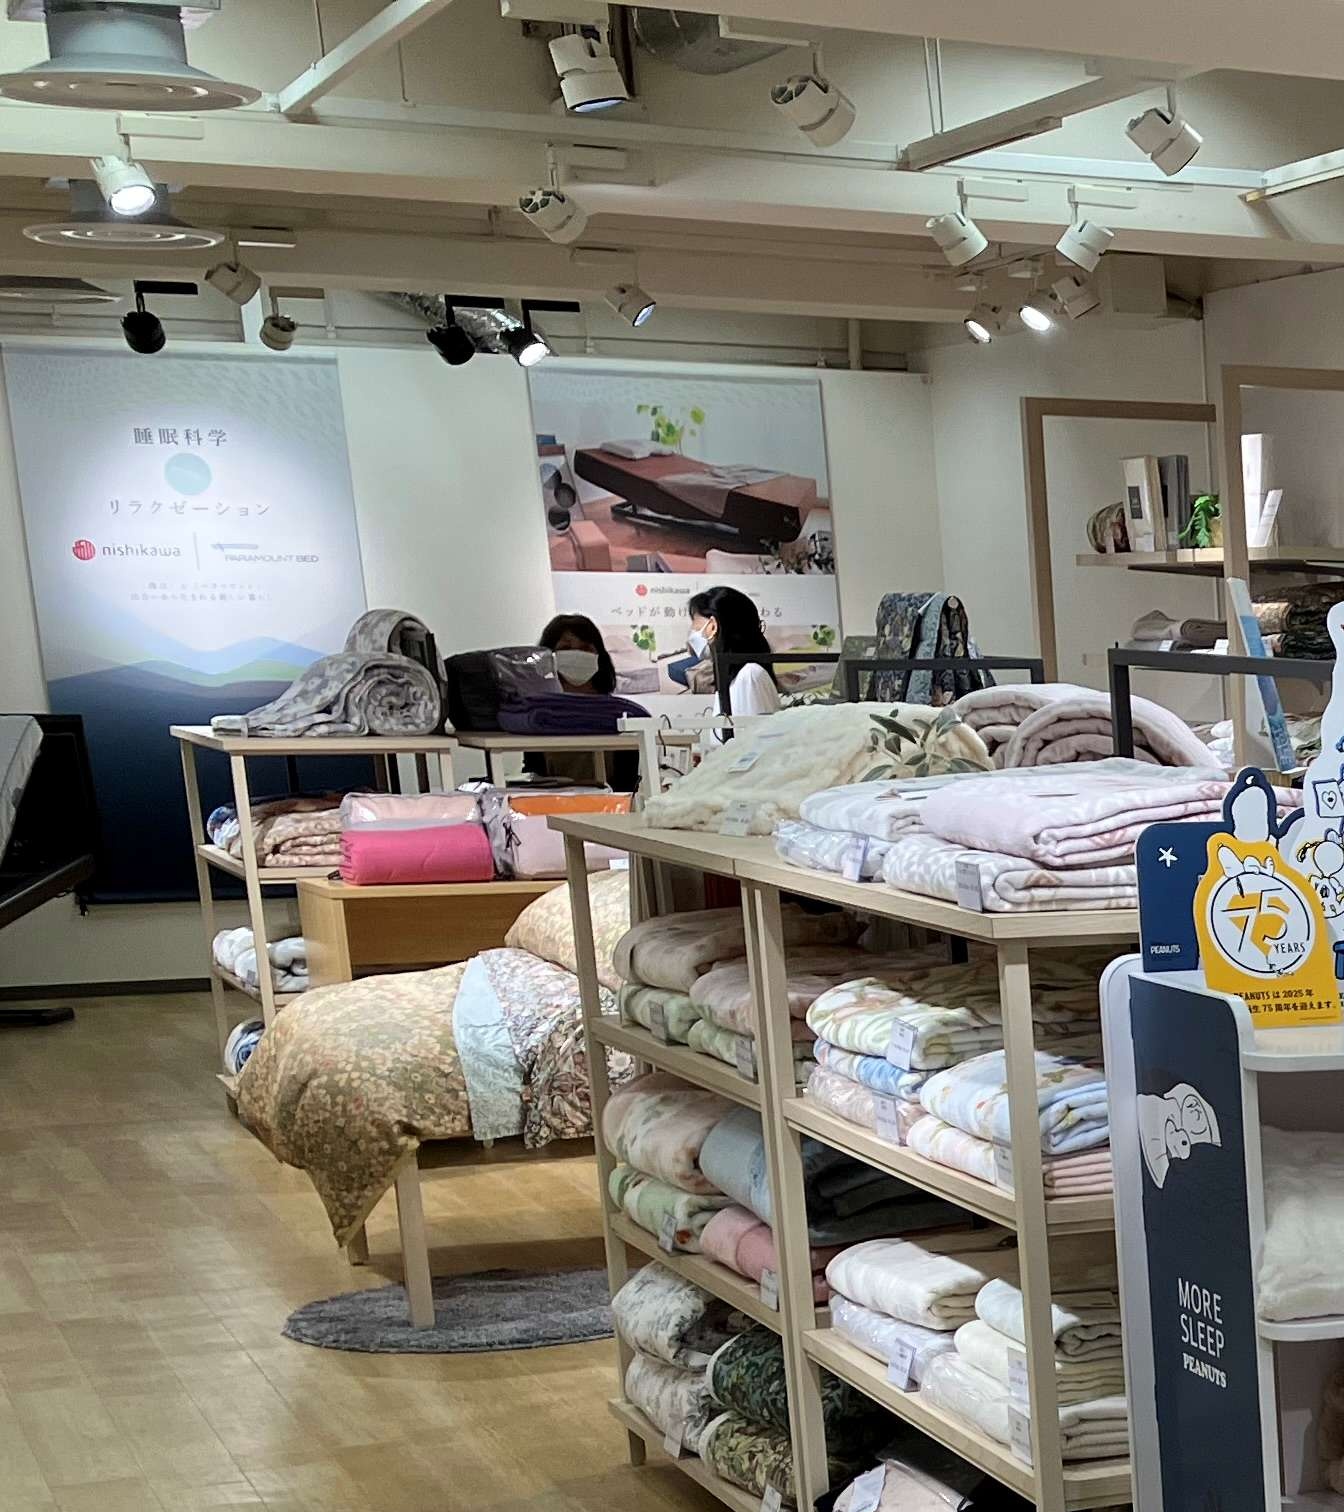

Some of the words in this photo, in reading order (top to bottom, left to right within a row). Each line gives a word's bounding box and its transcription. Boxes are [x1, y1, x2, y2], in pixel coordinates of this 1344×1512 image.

[133, 427, 228, 447] 睡眠科学
[109, 499, 270, 517] リラクゼーション
[102, 543, 181, 558] nishikawa
[224, 553, 295, 564] PARAMOUNT
[296, 555, 319, 563] BED
[1150, 945, 1181, 954] PEANUTS
[1274, 942, 1306, 954] YEARS
[1178, 1277, 1223, 1325] MORE
[1180, 1313, 1225, 1359] SLEEP
[1183, 1352, 1227, 1388] PEANUTS
